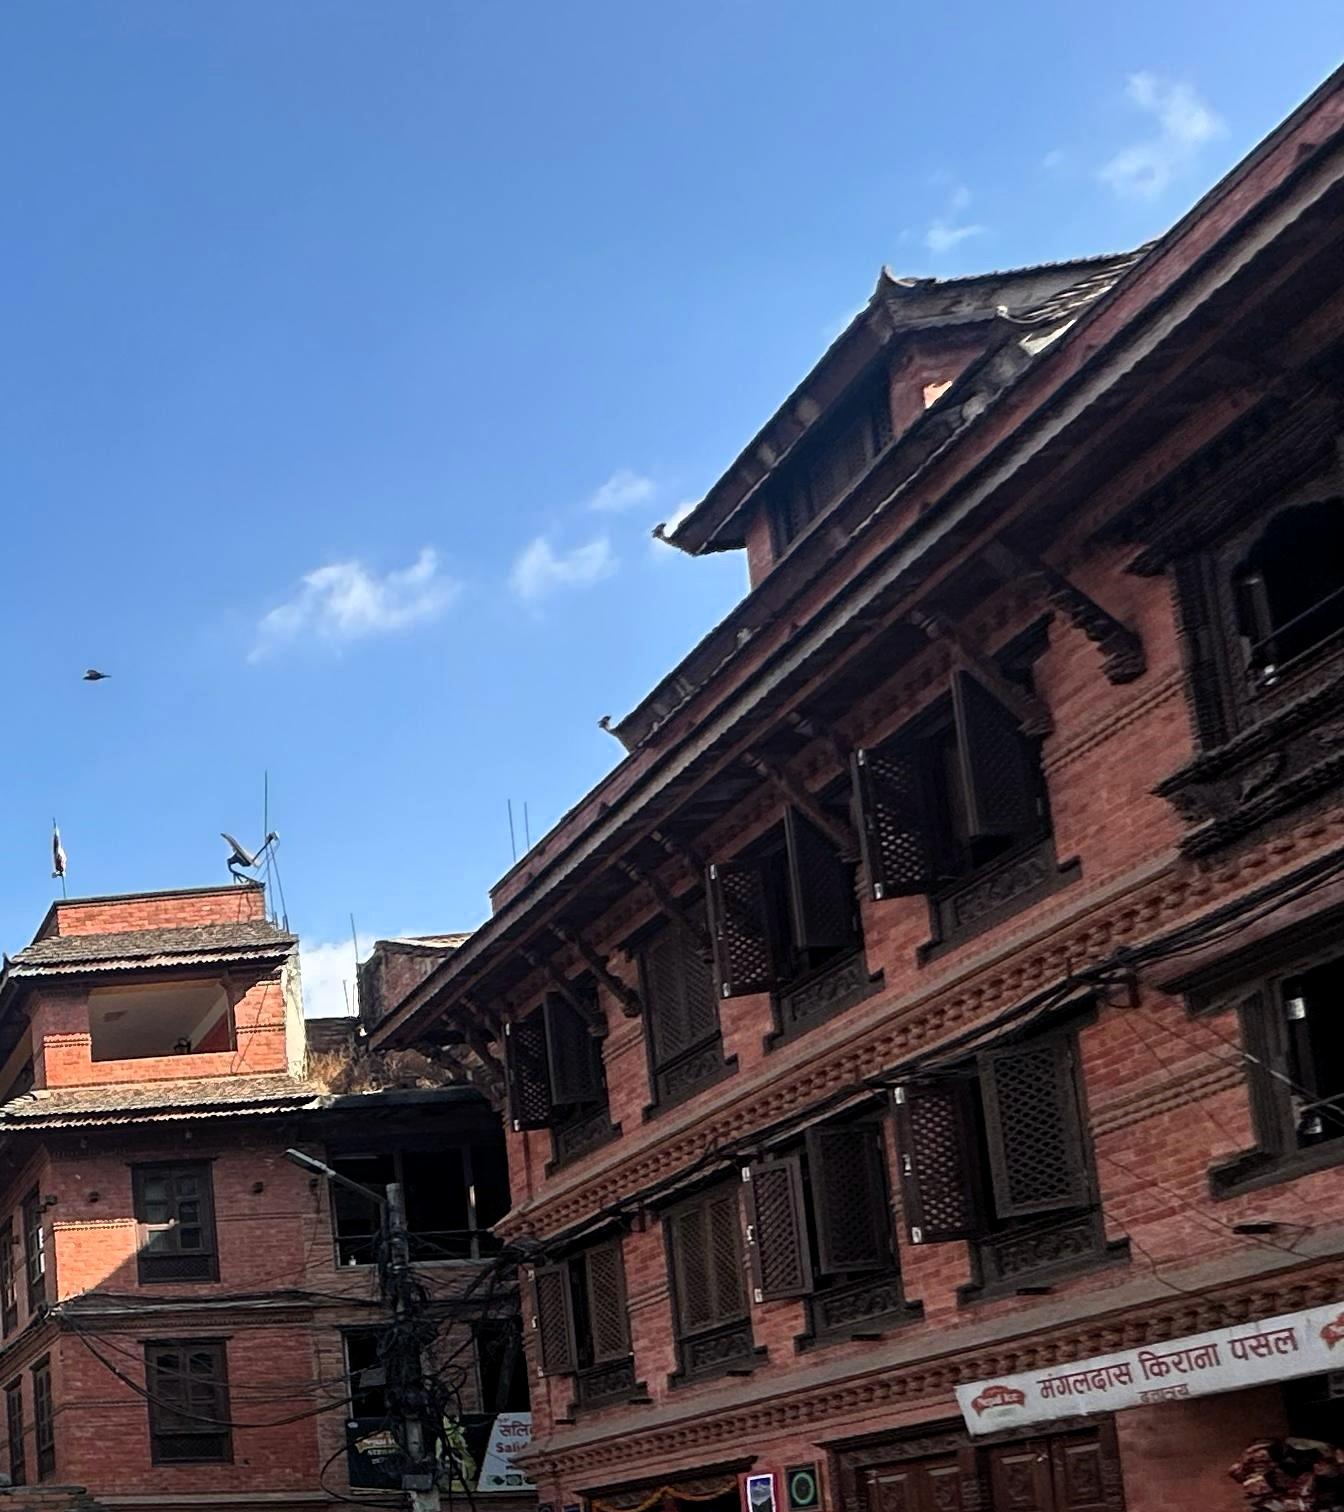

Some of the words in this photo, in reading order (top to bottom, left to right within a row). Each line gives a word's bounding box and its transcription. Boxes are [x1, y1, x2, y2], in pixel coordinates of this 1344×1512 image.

[1036, 1362, 1133, 1399] मंगलदास
[1138, 1343, 1222, 1381] किराना
[1227, 1327, 1299, 1362] पसल
